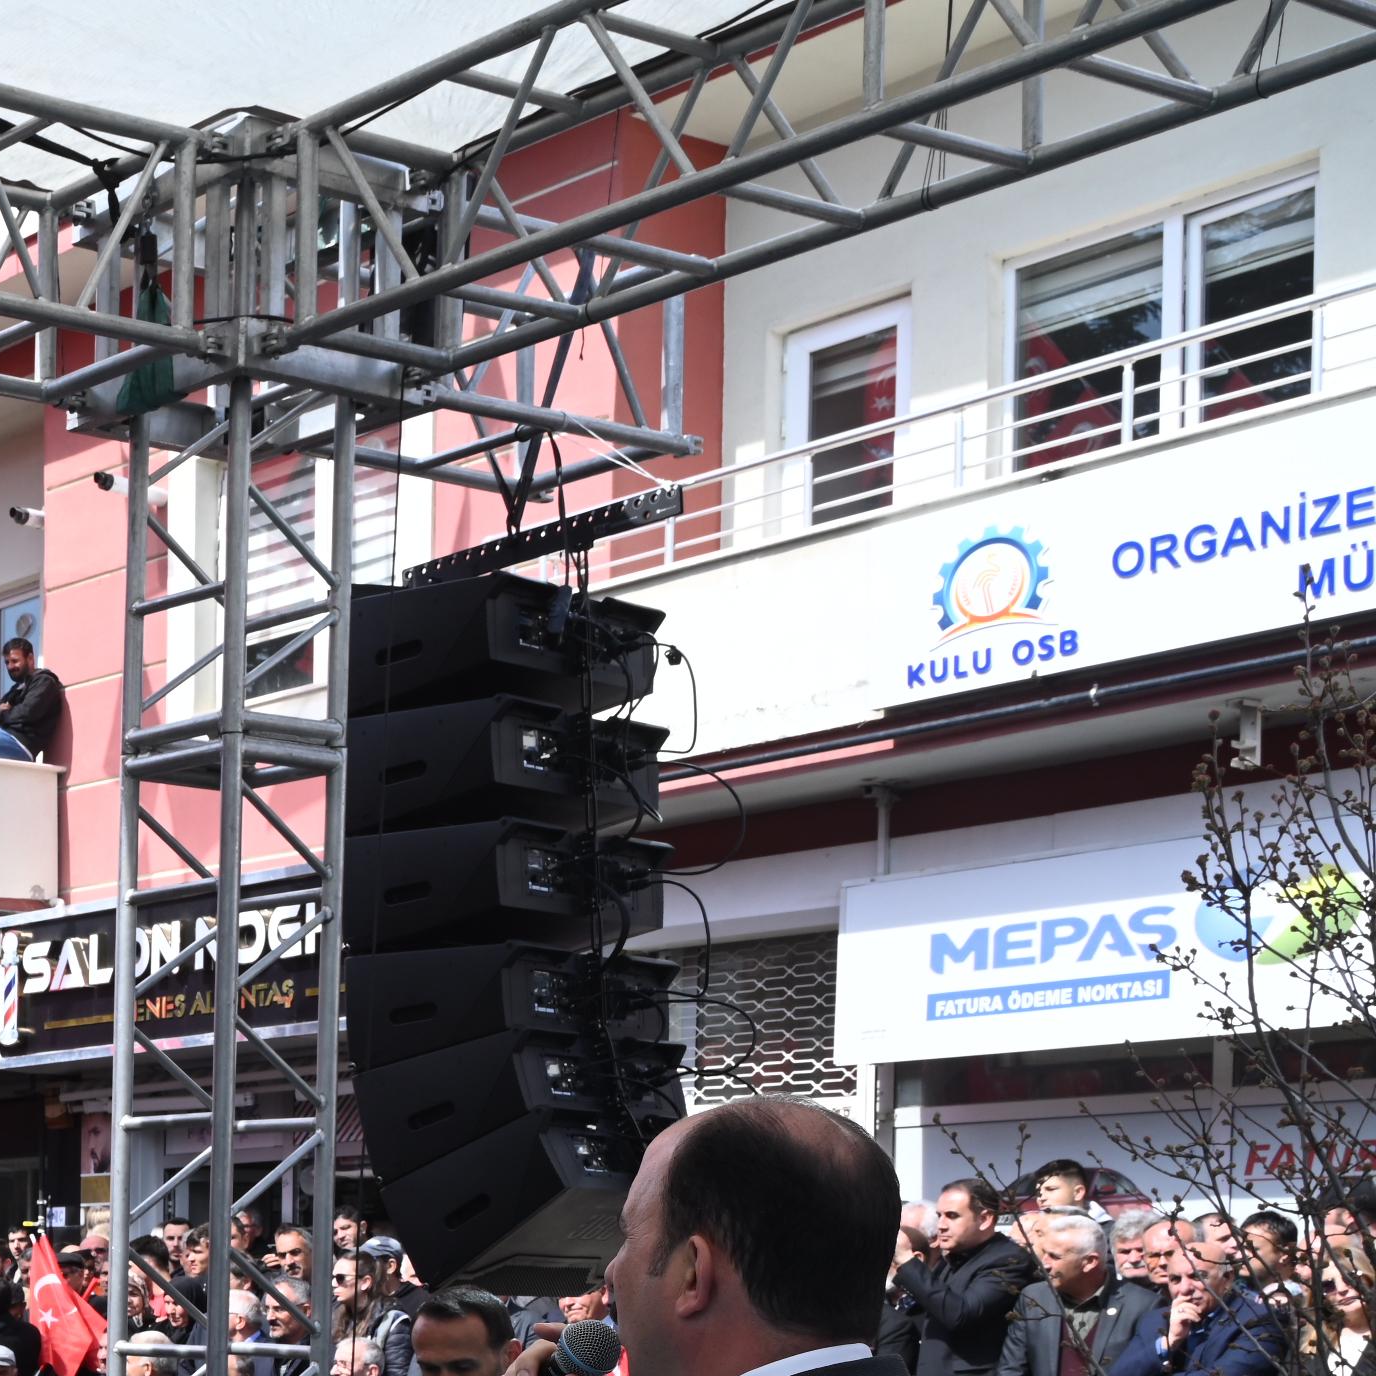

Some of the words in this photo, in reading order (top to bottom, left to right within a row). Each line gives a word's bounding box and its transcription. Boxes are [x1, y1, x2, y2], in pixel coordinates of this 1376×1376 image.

[1112, 485, 1376, 579] ORGANİZE
[906, 647, 992, 689] KULU
[1010, 629, 1079, 666] OSB
[934, 993, 1003, 1017] FATURA
[1007, 986, 1073, 1010] ÖDEME
[1077, 977, 1162, 1005] NOKTASI
